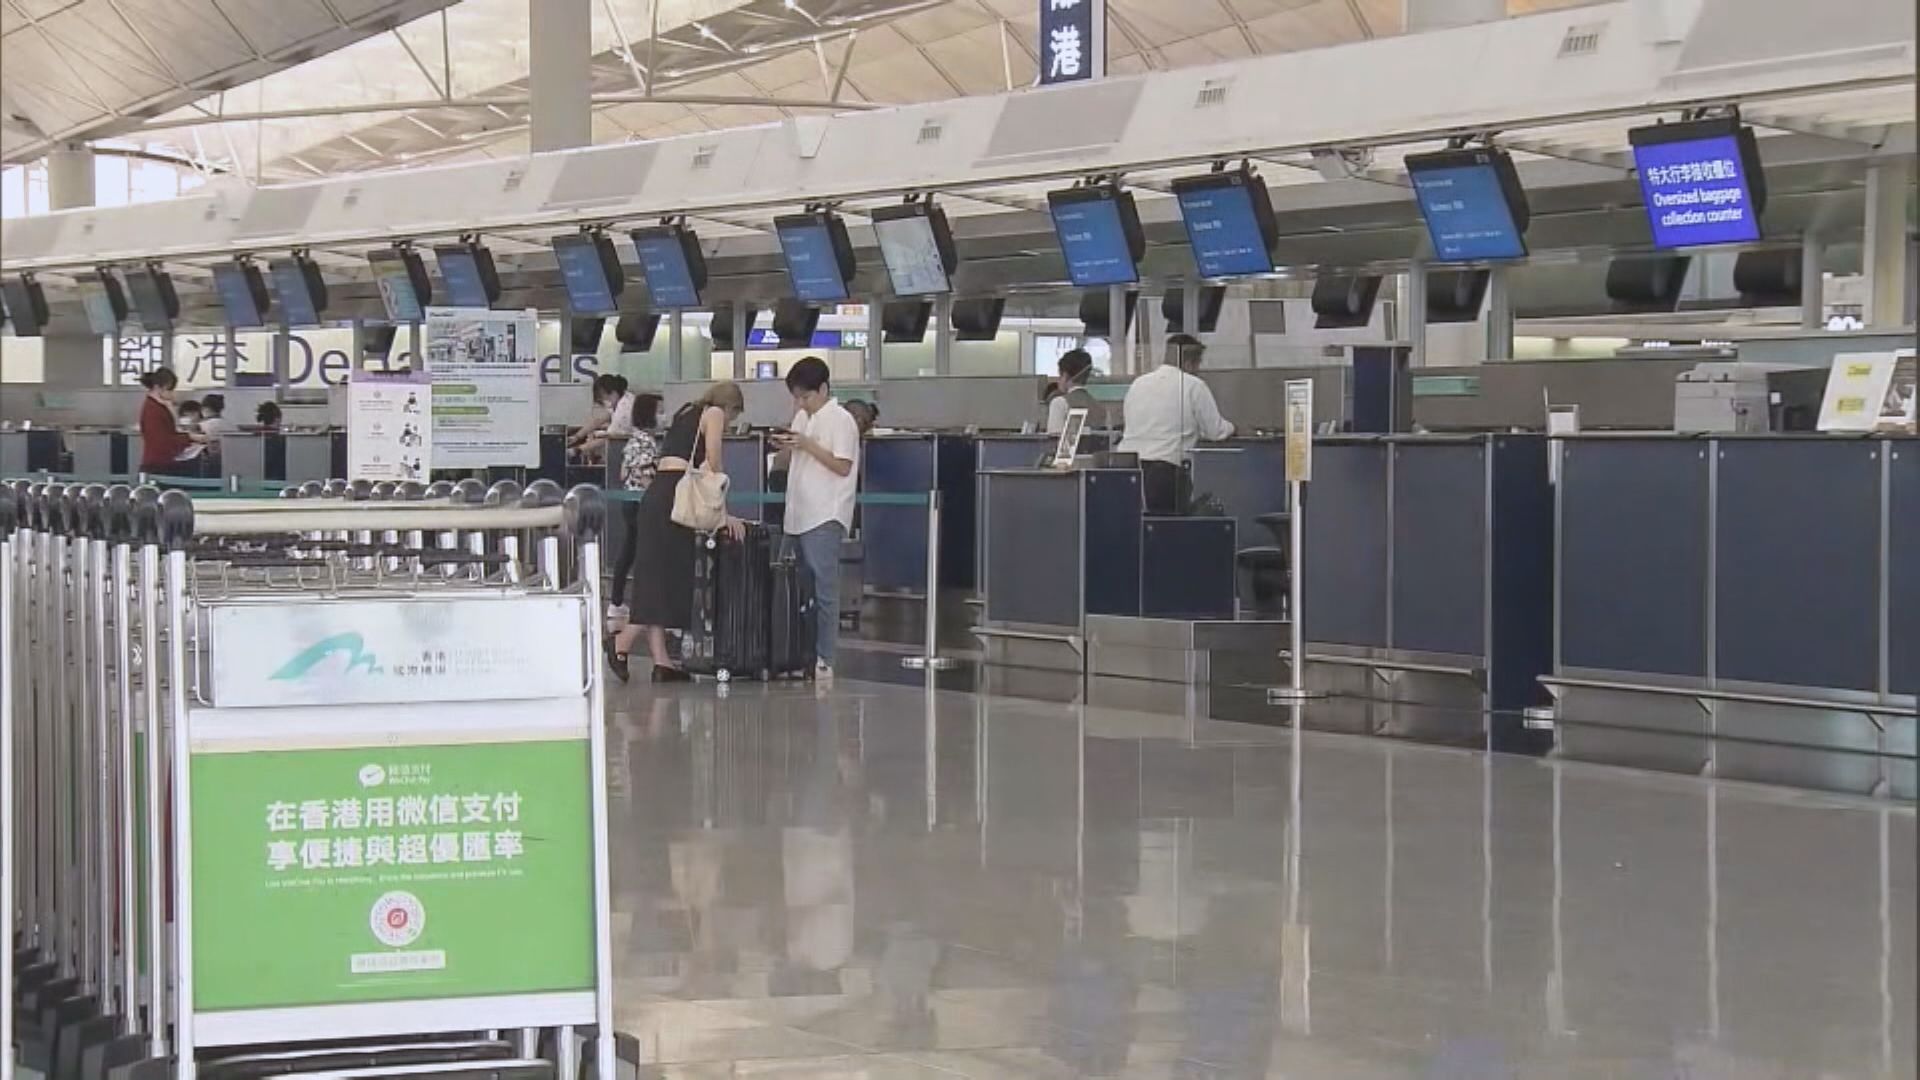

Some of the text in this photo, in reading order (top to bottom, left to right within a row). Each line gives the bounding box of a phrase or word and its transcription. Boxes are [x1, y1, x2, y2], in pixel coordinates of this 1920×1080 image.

[1653, 188, 1742, 207] Oversized baggage
[1661, 208, 1743, 227] collection counter
[266, 791, 523, 832] 在香港用微信支付
[267, 829, 524, 871] 享便捷與超優匯率
